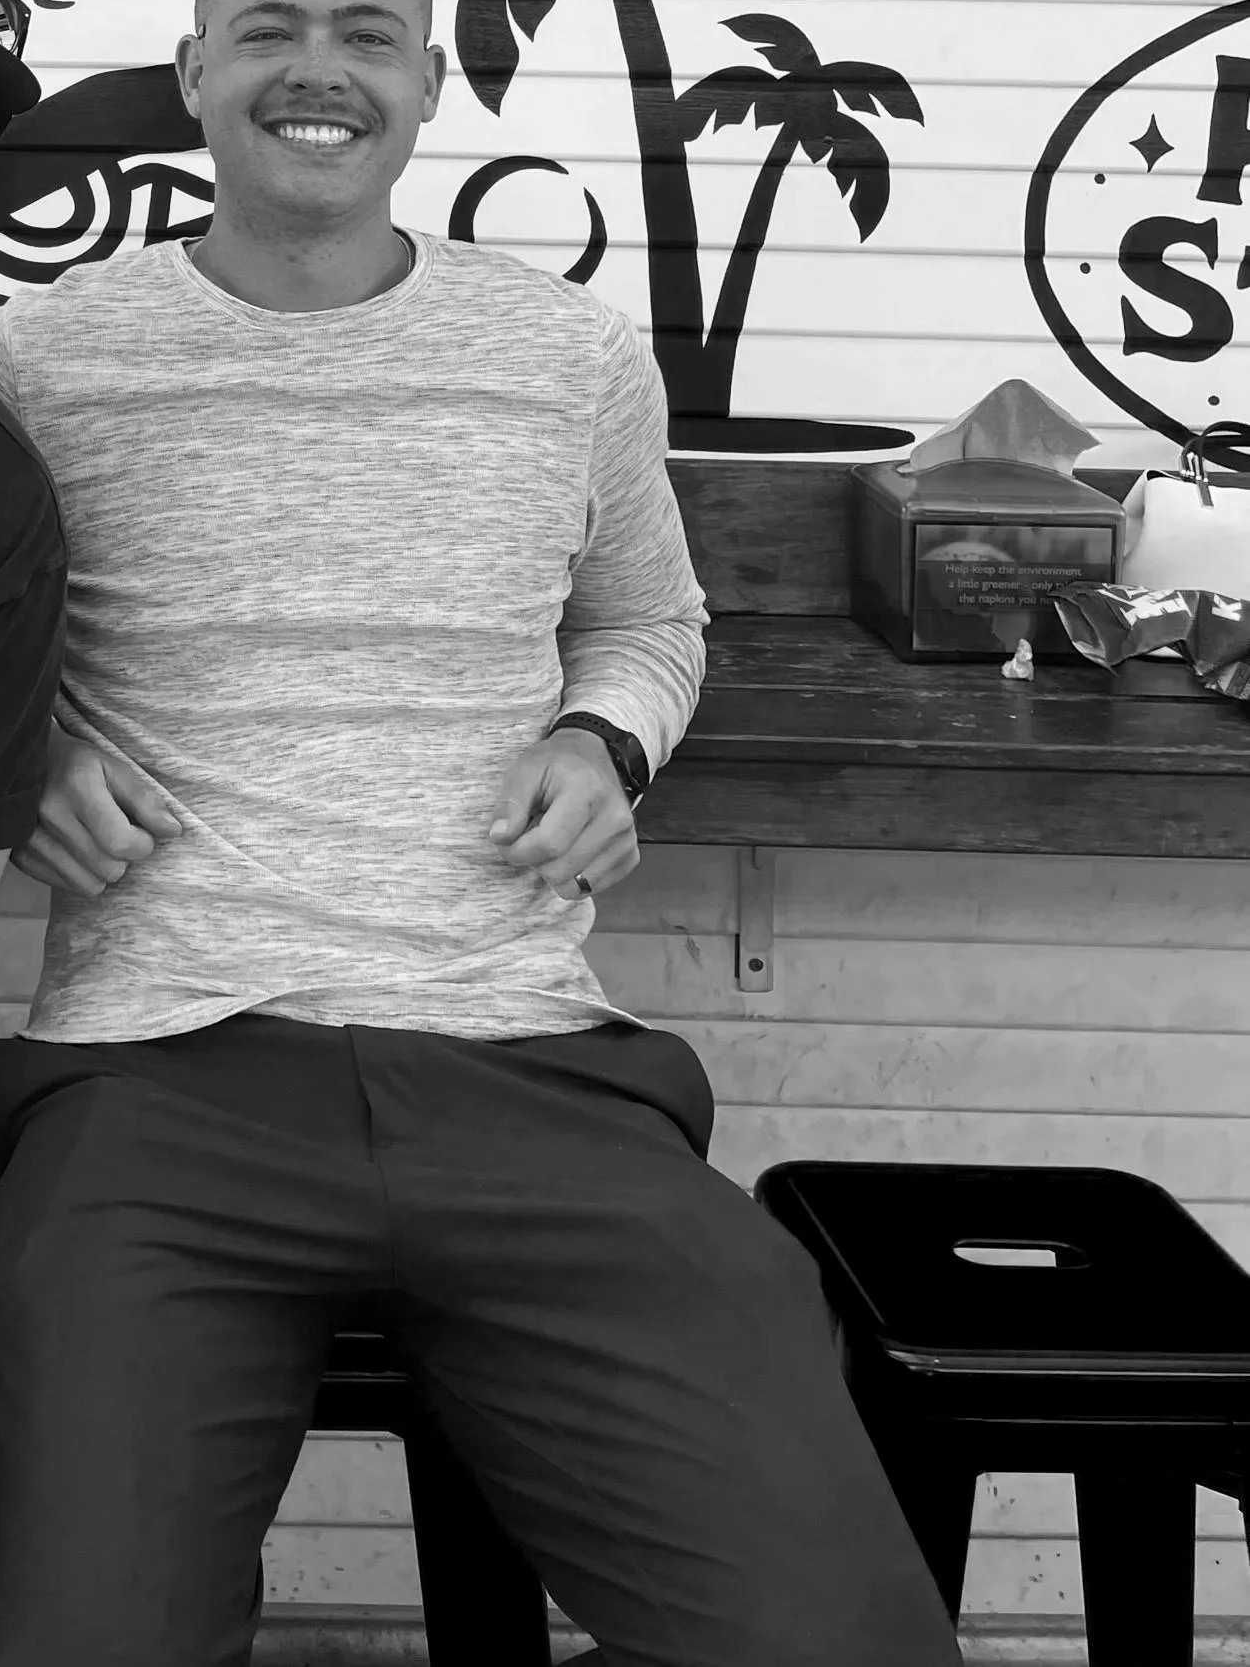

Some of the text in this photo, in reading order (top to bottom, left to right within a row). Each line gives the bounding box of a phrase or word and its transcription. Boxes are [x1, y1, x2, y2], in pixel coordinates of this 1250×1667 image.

[1118, 216, 1250, 362] S
[945, 564, 1082, 576] Help keep the environment
[957, 579, 979, 589] little
[982, 580, 1021, 591] greener
[1031, 580, 1053, 592] only
[959, 594, 975, 603] the
[978, 594, 1015, 606] napkins
[1018, 597, 1037, 606] you
